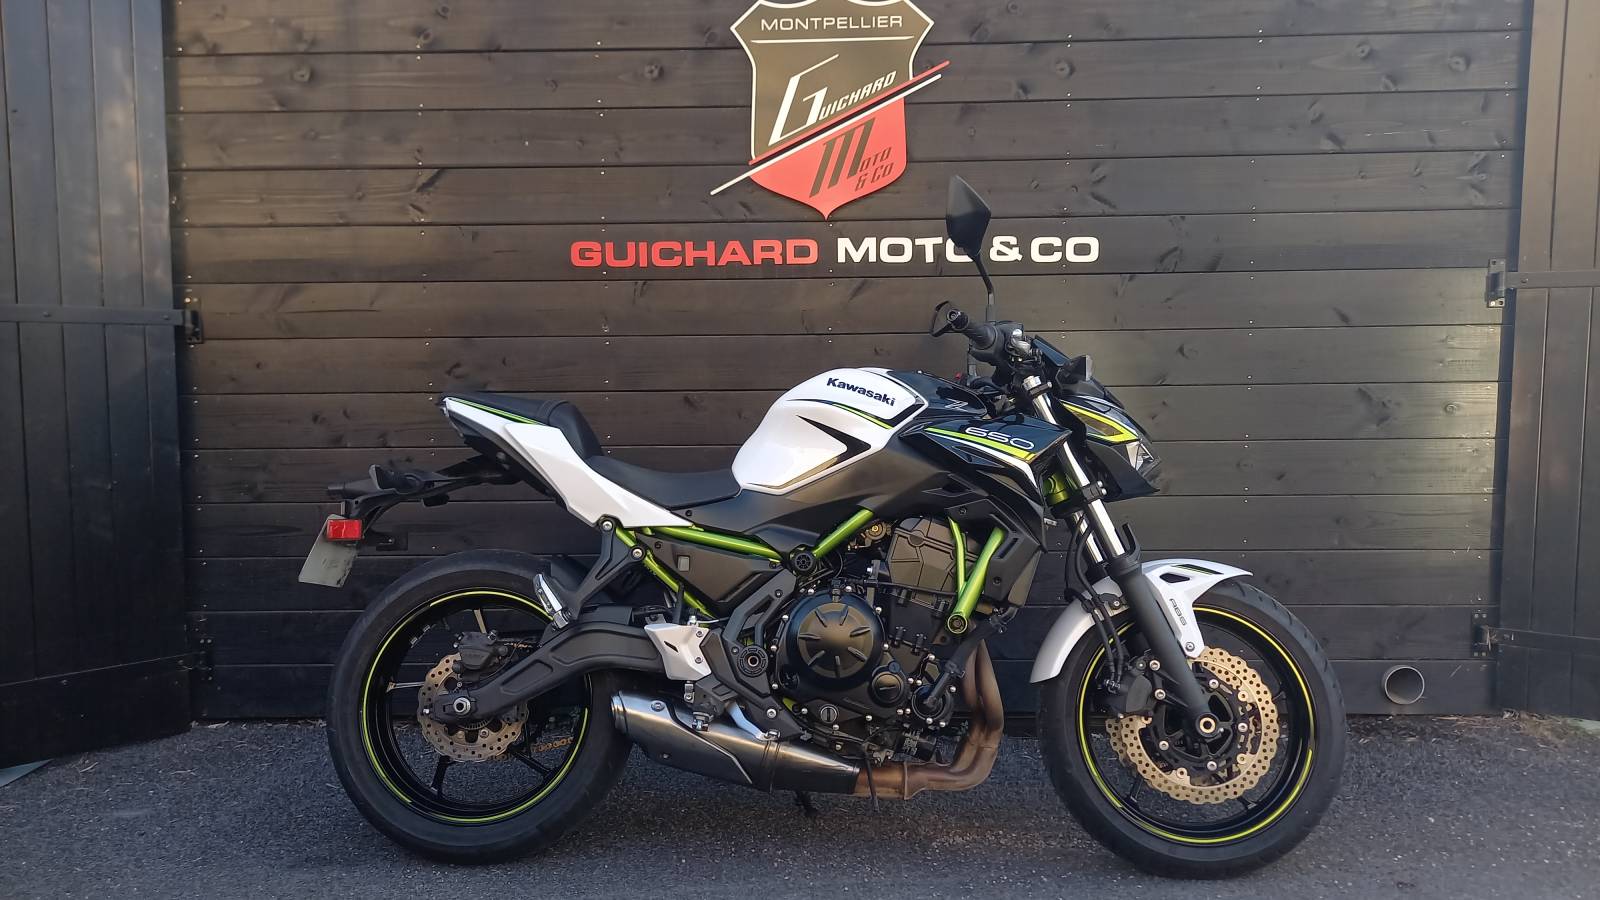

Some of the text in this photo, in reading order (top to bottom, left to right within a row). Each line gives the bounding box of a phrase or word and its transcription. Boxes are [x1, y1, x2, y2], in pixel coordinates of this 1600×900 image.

[761, 15, 903, 31] MONTPELLIER
[768, 53, 897, 147] GUICHARD
[570, 238, 818, 267] GUICHARD
[989, 235, 1023, 262] &
[1030, 236, 1099, 263] CO
[826, 377, 896, 406] Kawasaki
[965, 426, 1035, 450] 650
[1168, 598, 1187, 626] ABS
